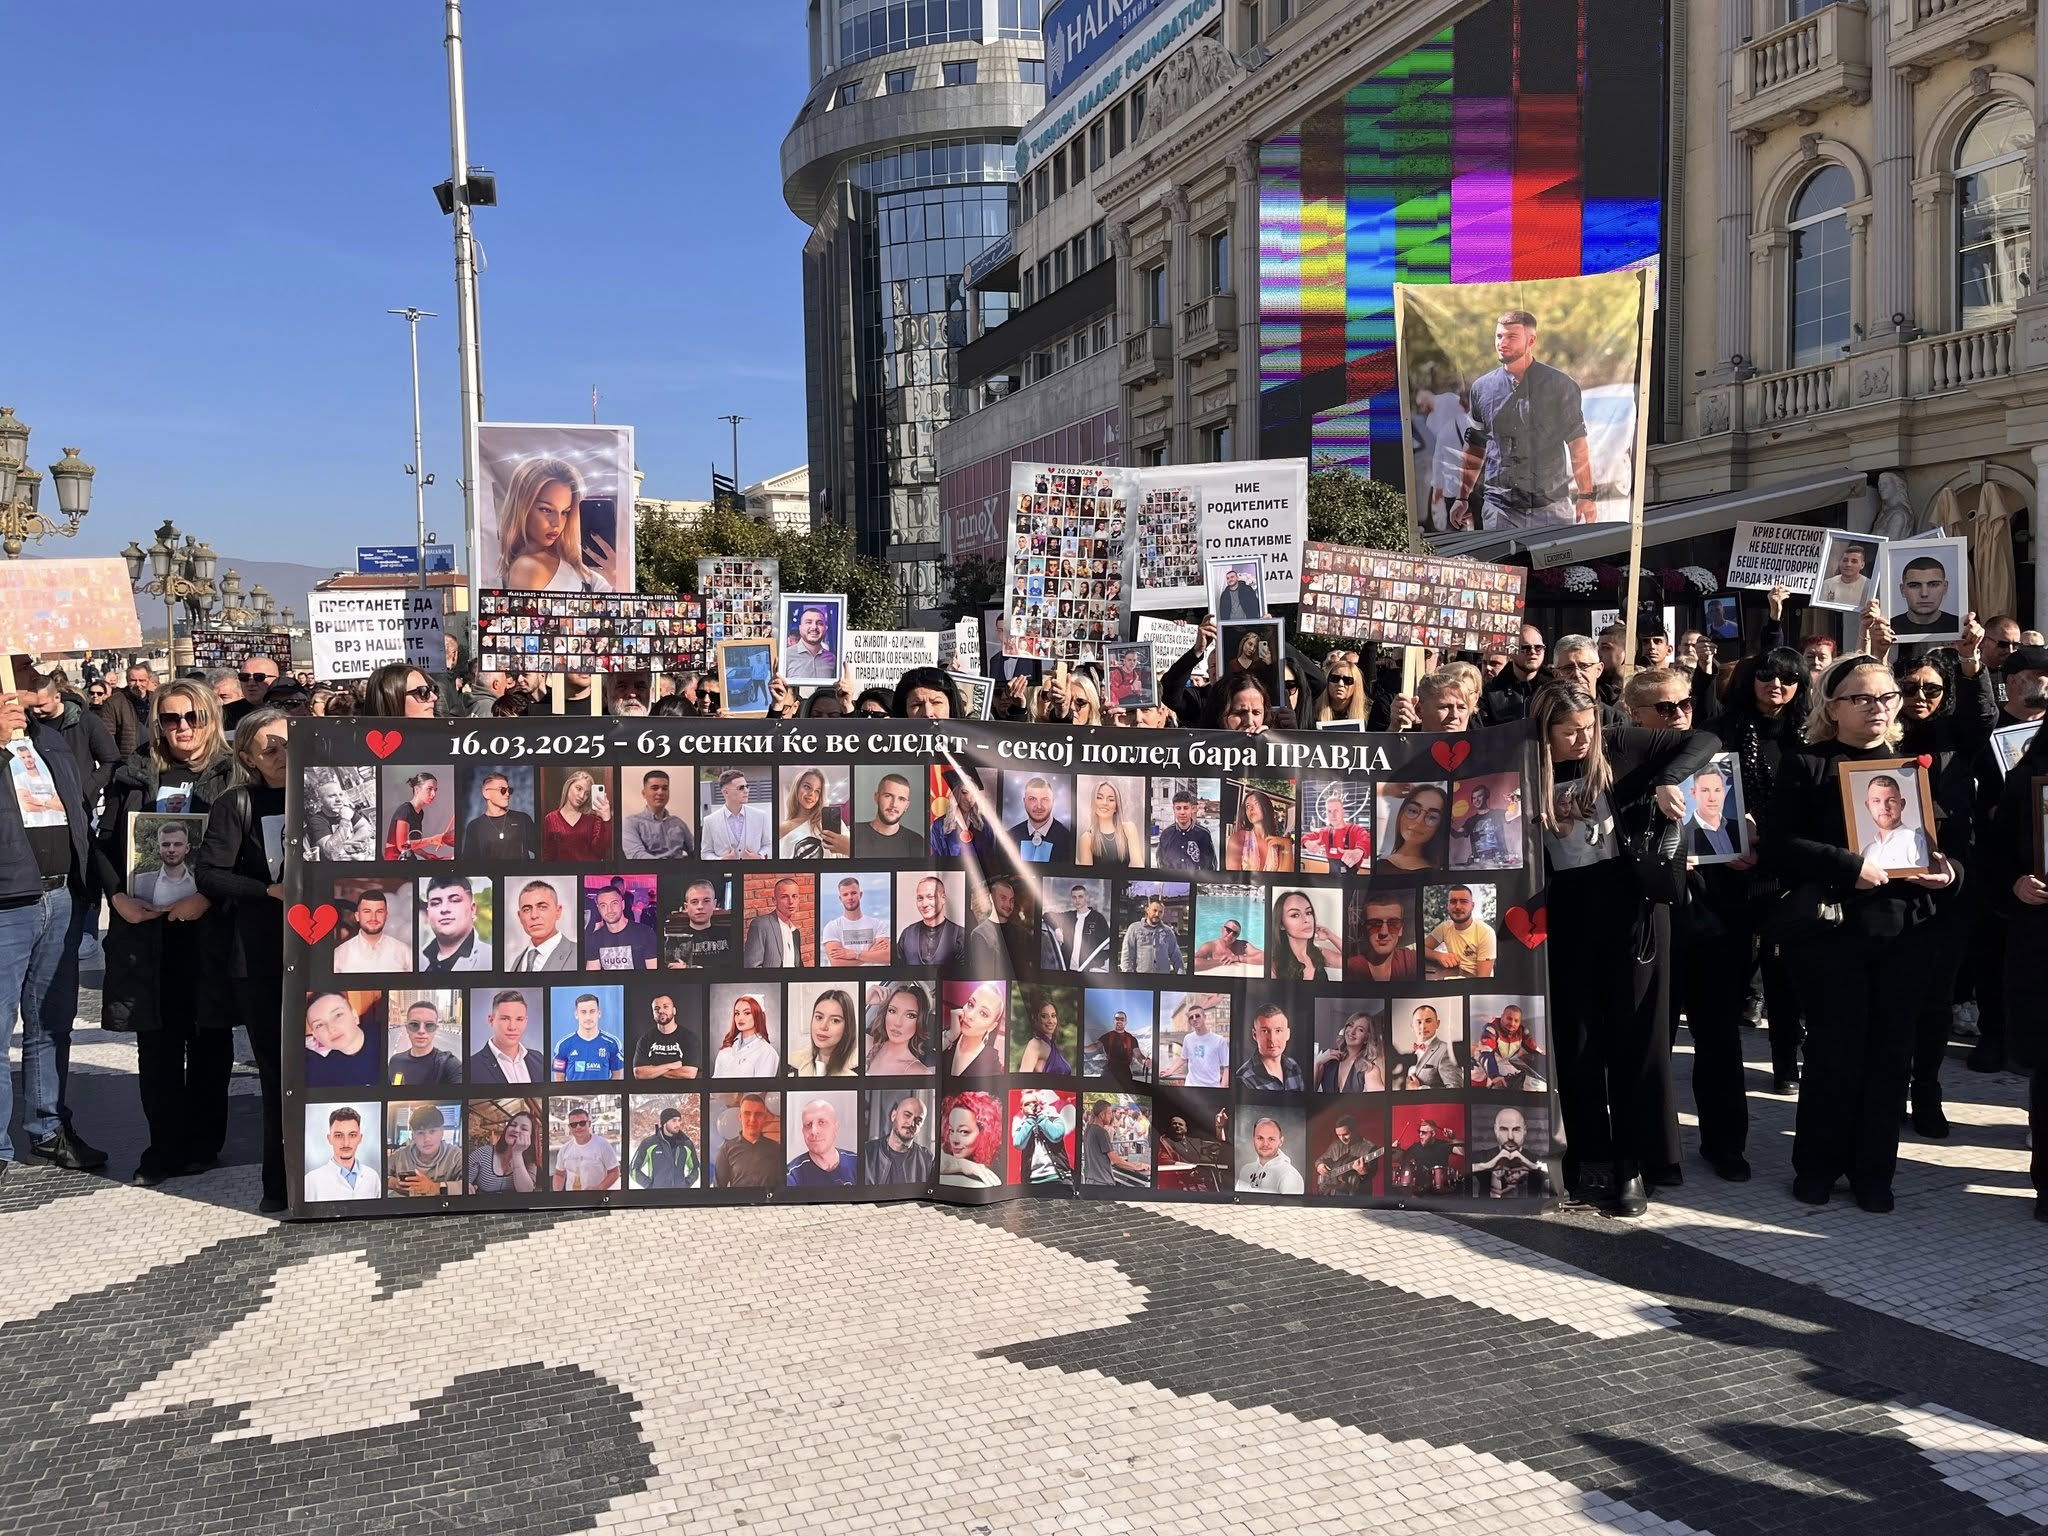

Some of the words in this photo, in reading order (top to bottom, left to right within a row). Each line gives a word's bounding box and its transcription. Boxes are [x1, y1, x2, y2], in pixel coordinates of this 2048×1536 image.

[1030, 105, 1076, 159] TURKISH
[1078, 64, 1123, 119] MAARIF
[1235, 482, 1260, 493] НИЕ
[1208, 499, 1289, 514] РОДИТЕЛИТЕ
[1228, 518, 1269, 530] СКАПО
[1752, 526, 1774, 539] КРИВ
[1775, 528, 1780, 539] Е
[1206, 538, 1221, 549] ГО
[1225, 535, 1292, 548] ПЛАТИВМЕ
[1749, 541, 1760, 553] НЕ
[1761, 541, 1783, 555] БЕШЕ
[1272, 553, 1288, 563] НА
[1737, 556, 1760, 569] БЕШЕ
[1760, 558, 1819, 574] НЕОДГОВОРНО
[1265, 570, 1293, 581] ЈАТА
[1730, 571, 1761, 585] ПРАВДА
[1762, 574, 1772, 586] ЗА
[1774, 576, 1807, 588] НАШИТЕ
[319, 599, 410, 613] ПРЕСТАНЕТЕ
[414, 598, 433, 612] ДА
[315, 620, 374, 633] ВРШИТЕ
[379, 617, 439, 631] ТОРТУРА
[968, 626, 975, 639] 62
[335, 639, 361, 652] ВРЗ
[366, 637, 424, 652] НАШИТЕ
[855, 635, 861, 648] 62
[862, 635, 887, 648] ЖИВОТИ
[892, 636, 899, 648] 62
[960, 642, 967, 654] 62
[419, 656, 430, 669] !!!
[846, 651, 852, 664] 62
[853, 651, 885, 664] СЕМЕЈСТВА
[887, 651, 894, 664] СО
[895, 651, 912, 664] ВЕЧНА
[856, 667, 878, 681] ПРАВДА
[880, 667, 885, 679] И
[449, 730, 606, 759] 16.03.2025
[637, 729, 671, 758] 63
[679, 735, 774, 754] сенки
[781, 727, 818, 753] ќе
[825, 734, 860, 753] ве
[867, 734, 968, 757] следат
[997, 736, 1074, 767] секој
[1081, 744, 1181, 769] поглед
[1188, 740, 1258, 772] бара
[1265, 743, 1392, 776] ПРАВДА
[604, 957, 628, 965] HUGO
